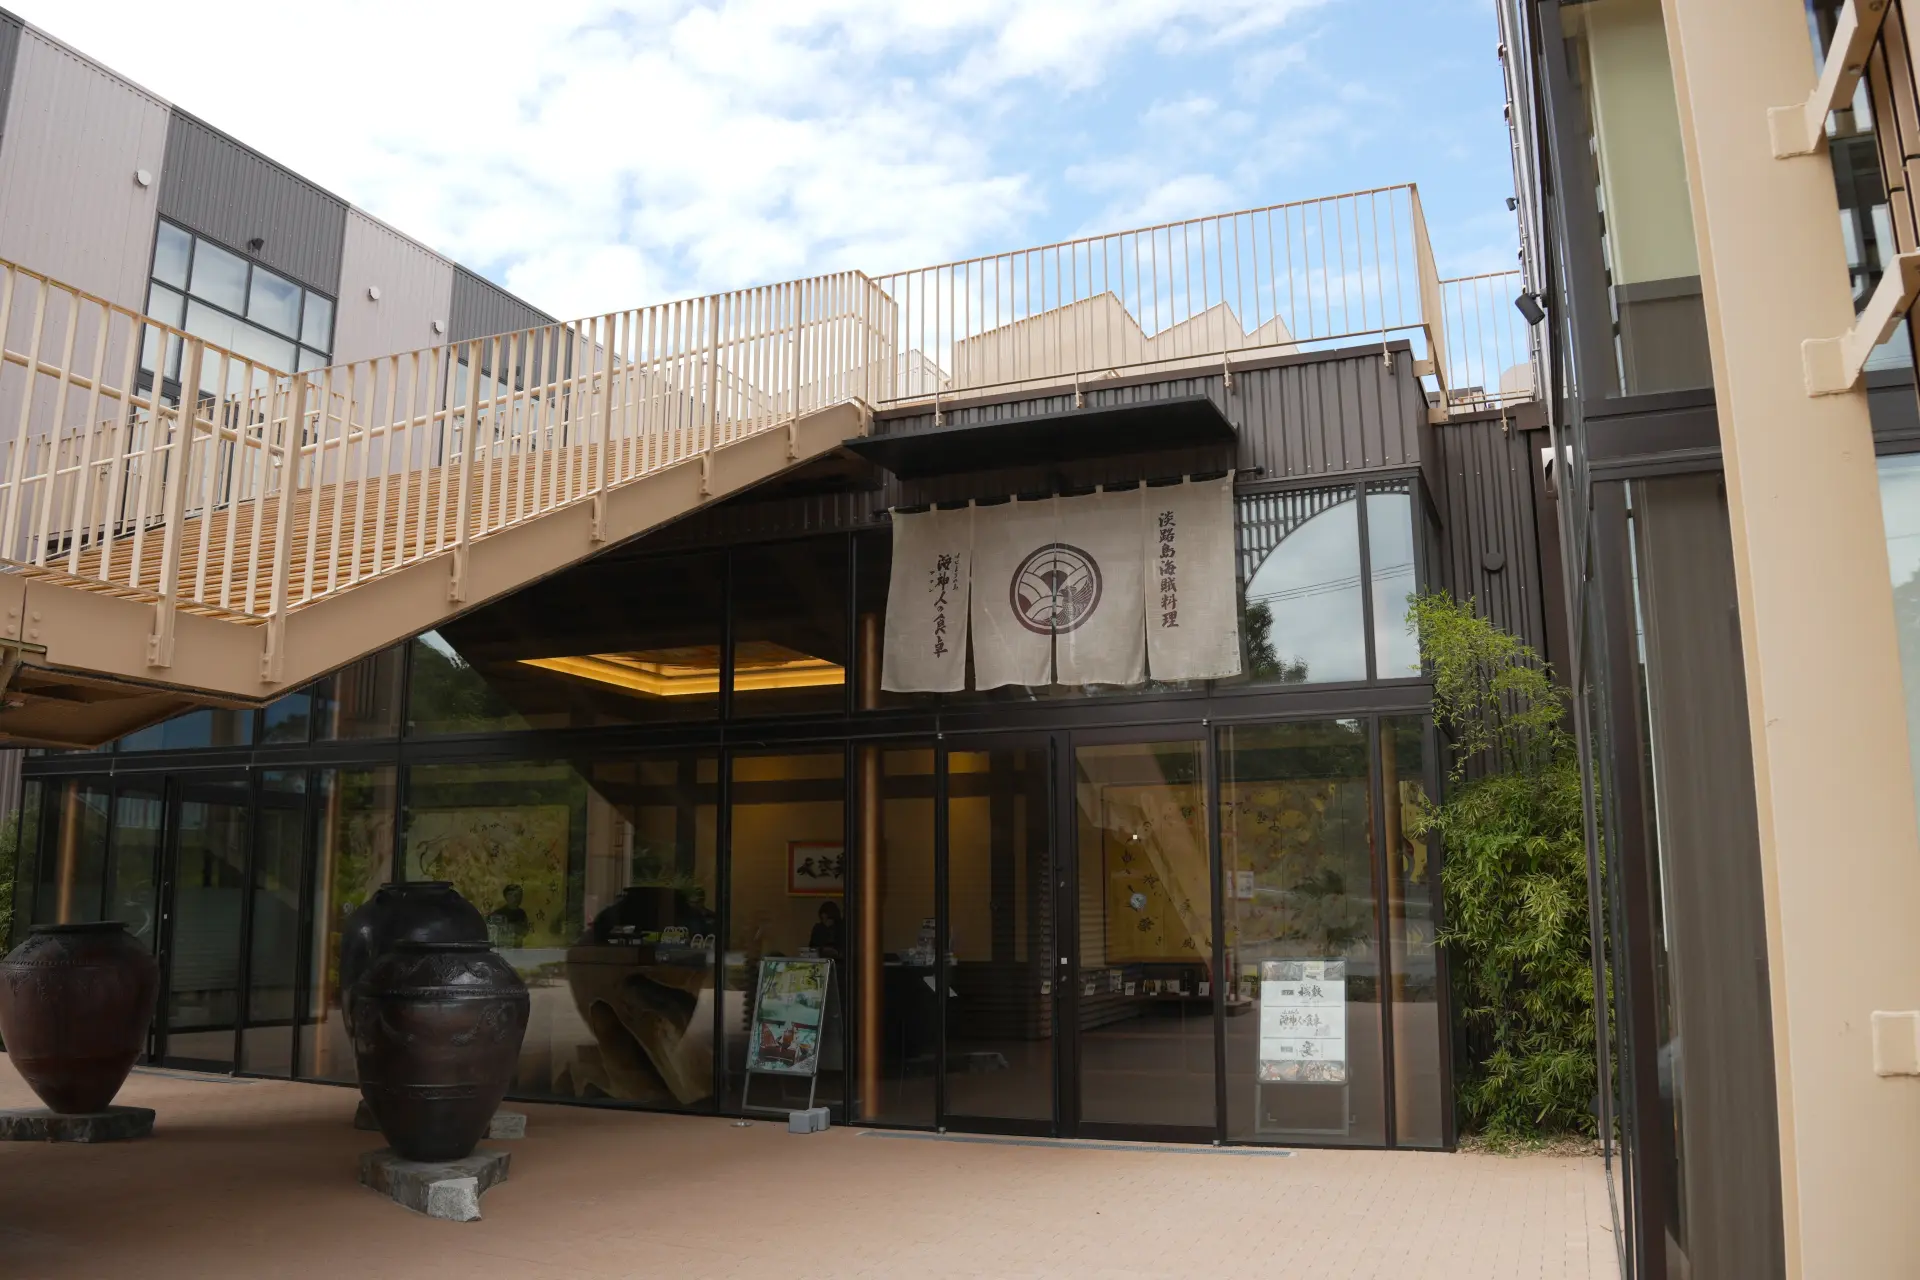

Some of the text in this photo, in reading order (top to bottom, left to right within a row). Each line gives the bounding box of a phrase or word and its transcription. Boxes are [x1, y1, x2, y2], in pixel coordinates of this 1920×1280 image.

[1158, 510, 1179, 628] 淡路島海賊料理
